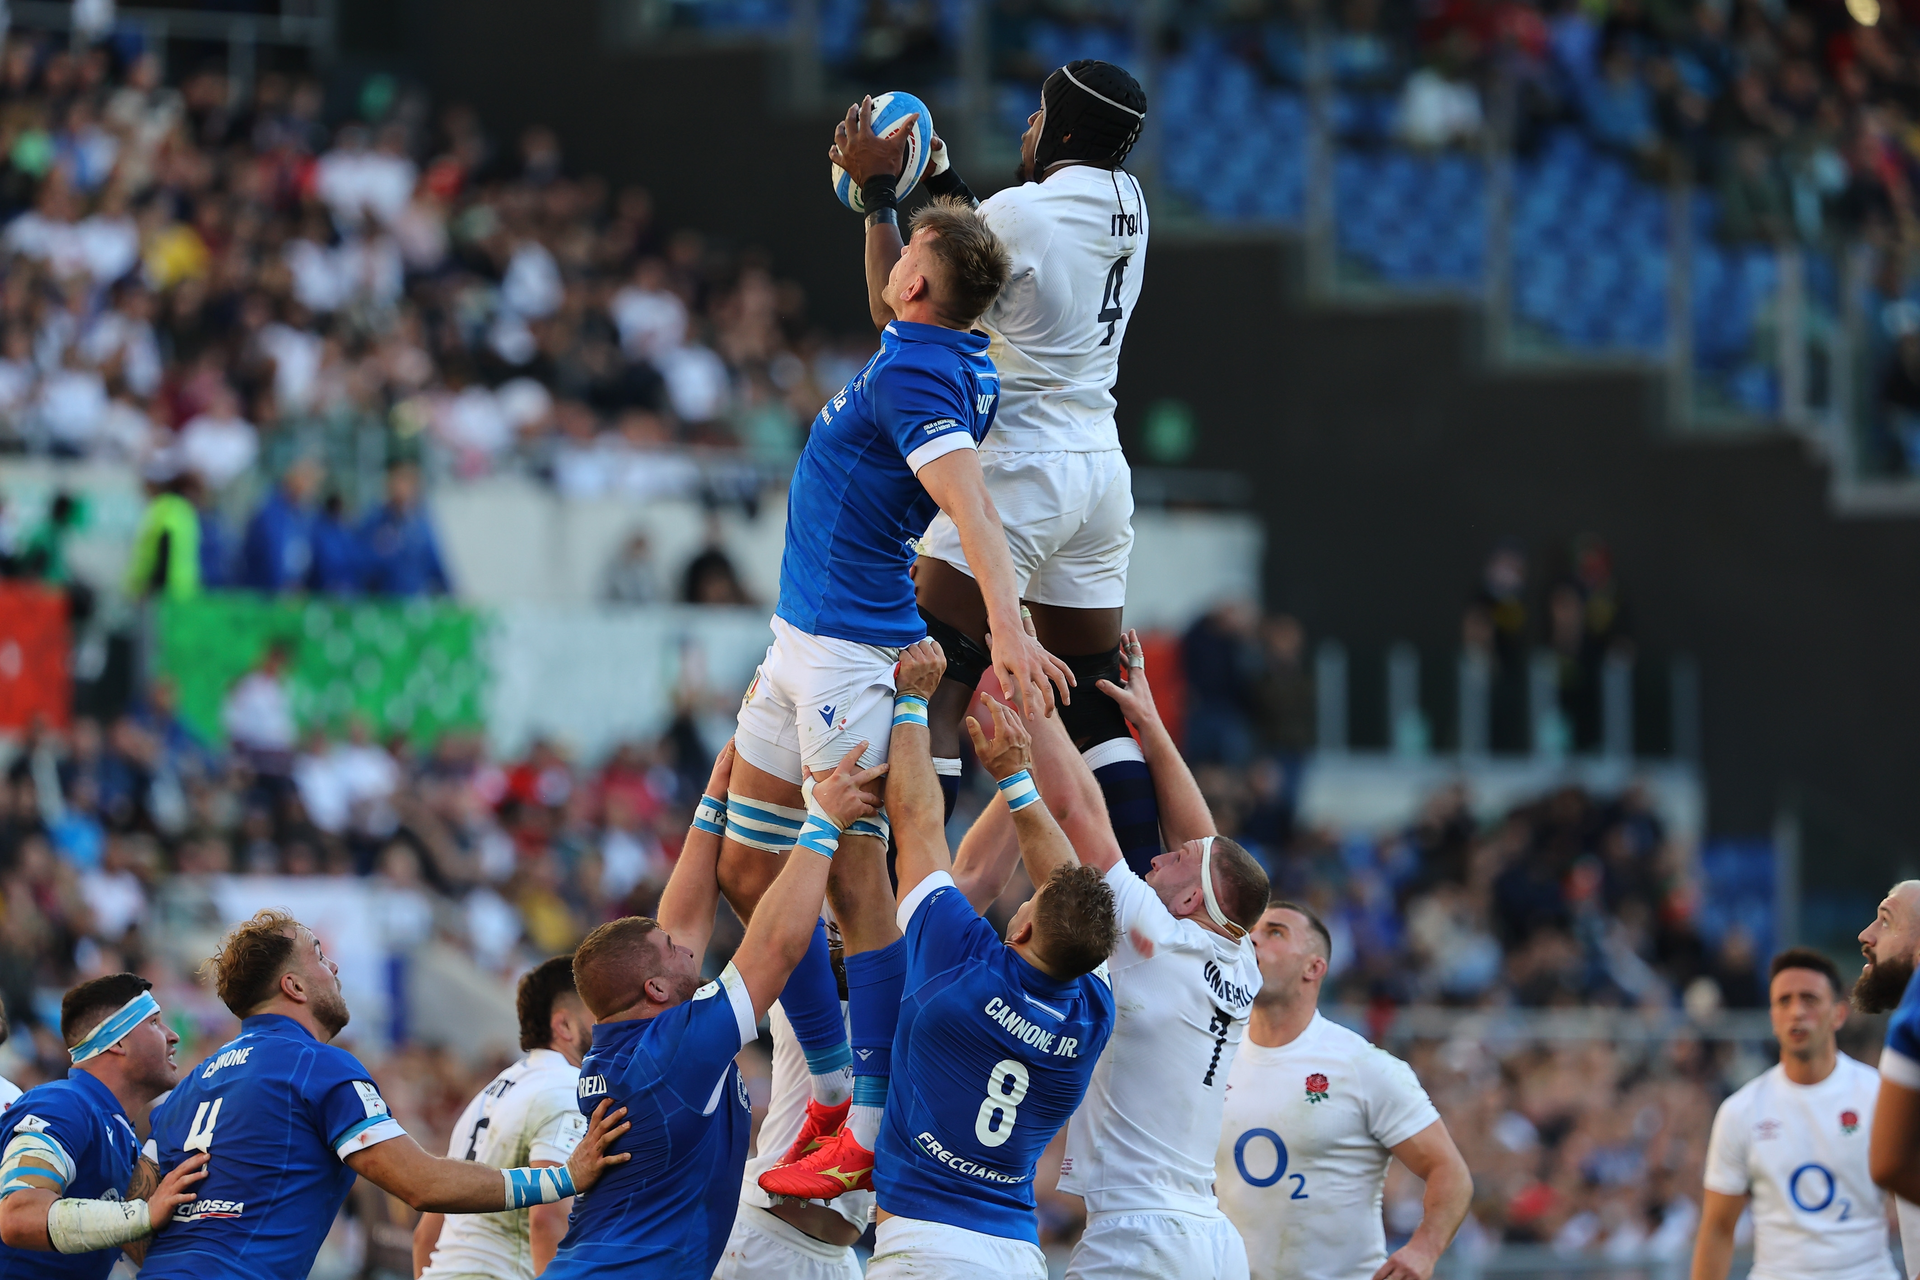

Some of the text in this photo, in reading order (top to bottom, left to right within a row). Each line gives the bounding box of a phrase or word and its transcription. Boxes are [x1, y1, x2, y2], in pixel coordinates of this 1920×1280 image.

[1098, 256, 1129, 346] 4
[984, 997, 1079, 1058] CANNONE JR.
[1202, 1006, 1232, 1087] 7
[577, 1073, 608, 1100] RELLI
[975, 1059, 1030, 1148] 8
[183, 1097, 224, 1173] 4
